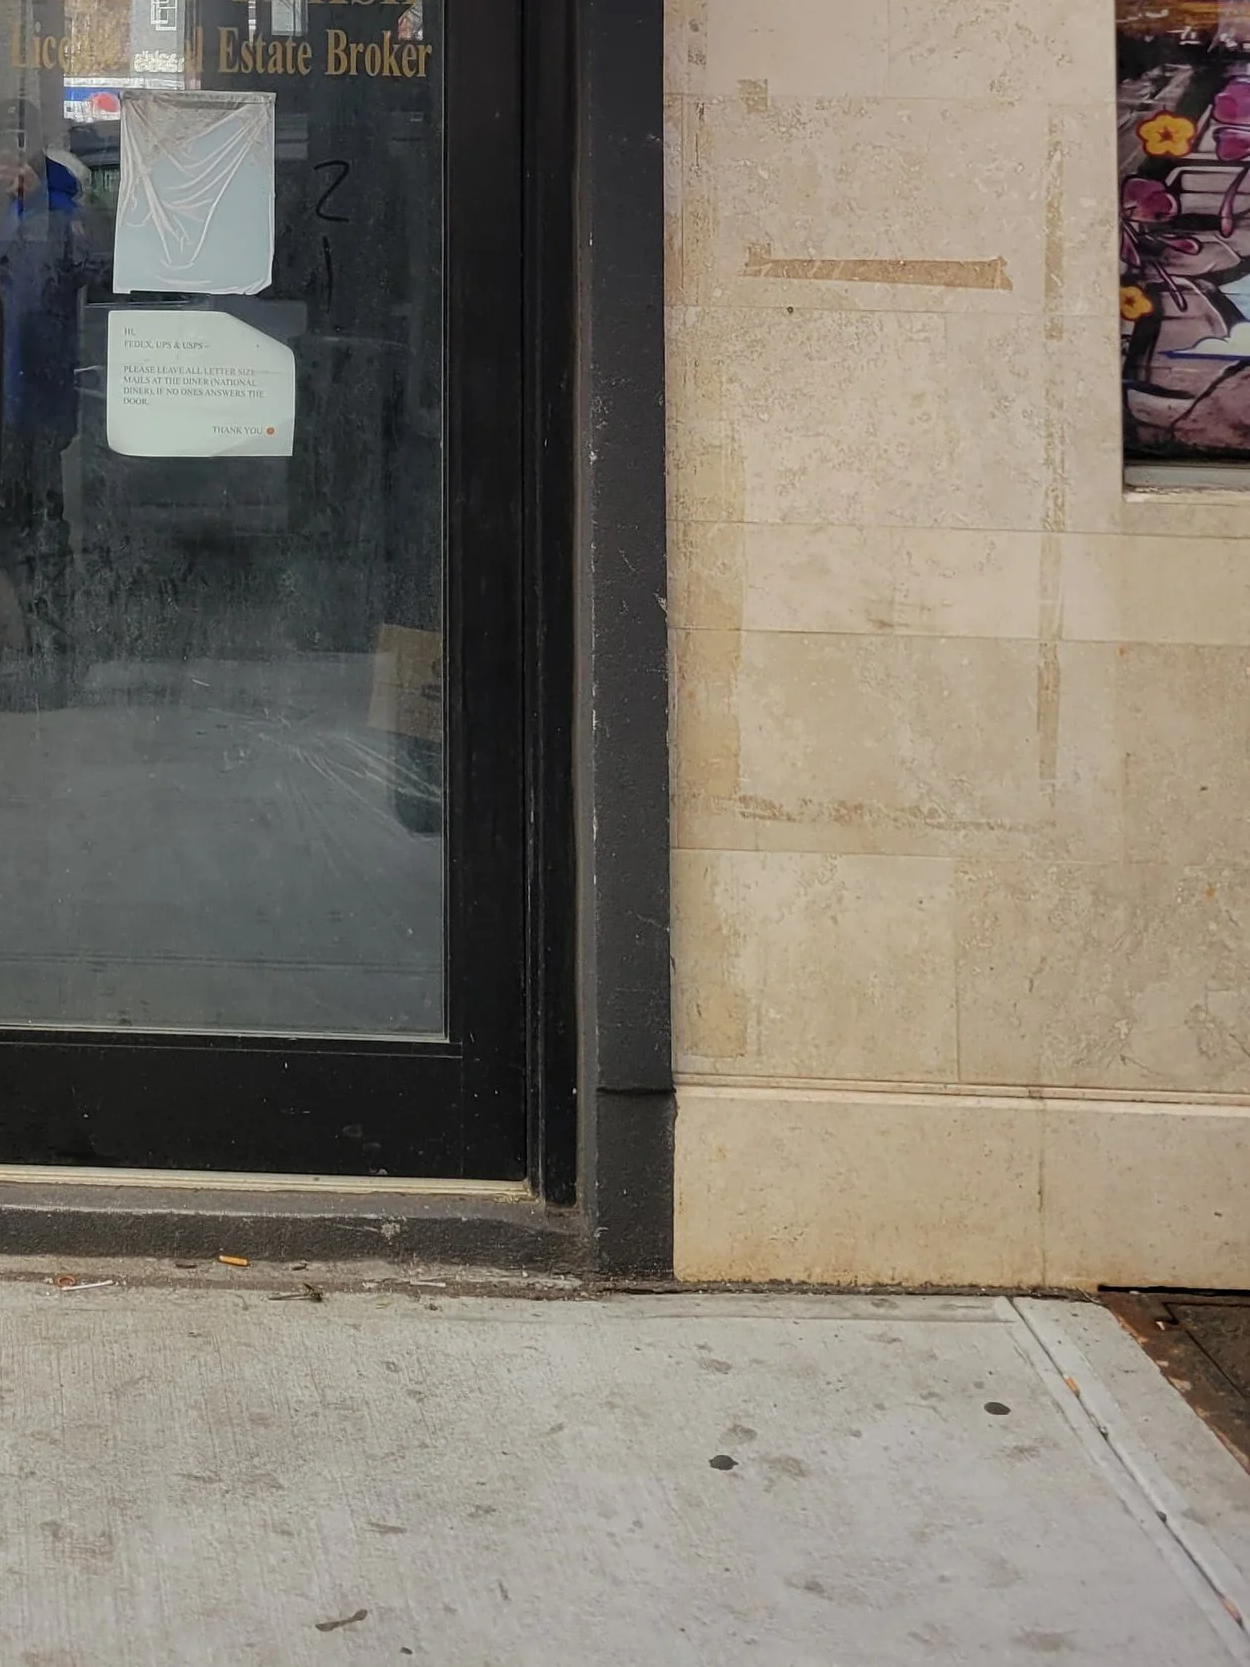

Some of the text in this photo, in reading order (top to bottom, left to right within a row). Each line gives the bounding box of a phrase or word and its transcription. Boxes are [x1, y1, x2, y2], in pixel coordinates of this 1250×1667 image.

[217, 25, 313, 77] Estate
[324, 28, 433, 78] Broker
[182, 342, 203, 350] USPS
[124, 365, 156, 373] PLEASE
[157, 366, 184, 374] LEAVE
[186, 367, 202, 375] ALL
[204, 367, 236, 375] LETTER
[164, 377, 181, 385] THE
[183, 377, 210, 385] DINER
[166, 388, 179, 396] NO
[180, 388, 204, 396] ONES
[206, 389, 246, 397] ANSWERS
[247, 390, 266, 398] THE
[213, 426, 263, 435] THANK YOU
